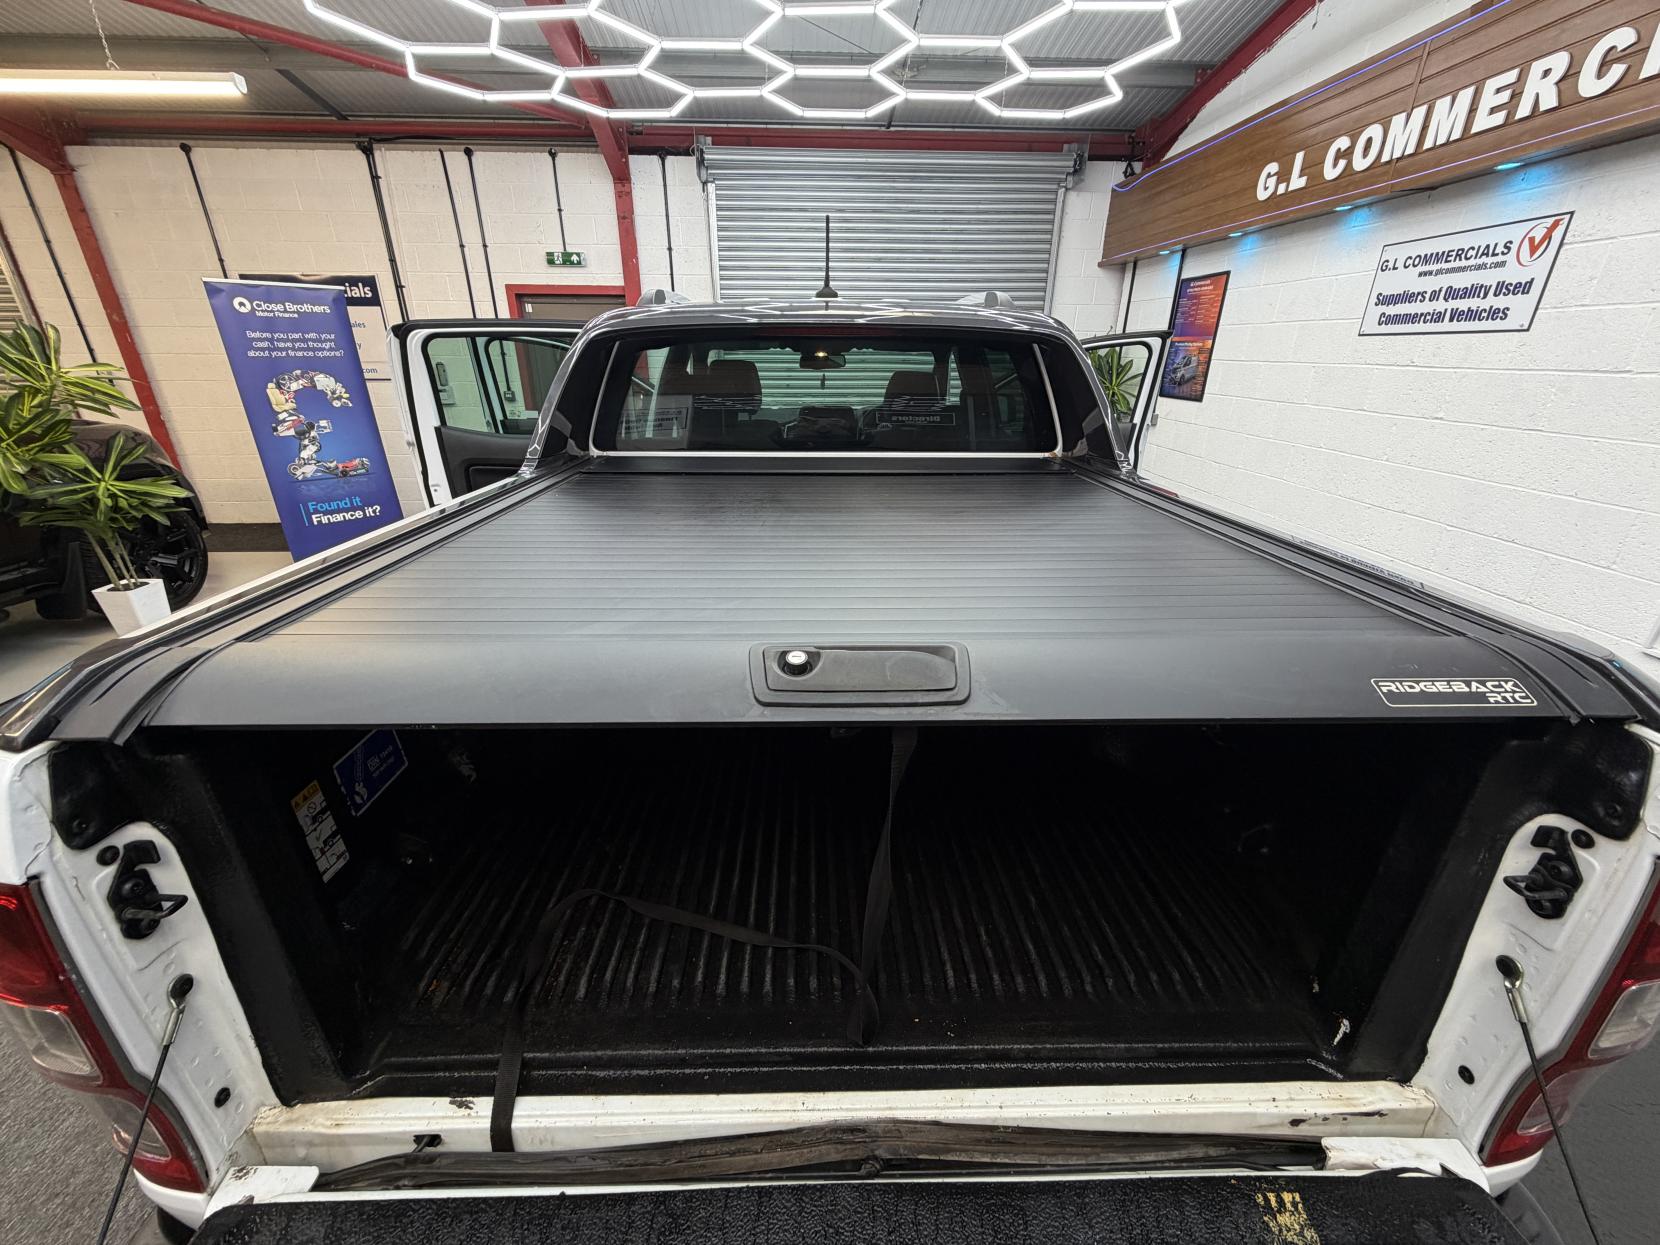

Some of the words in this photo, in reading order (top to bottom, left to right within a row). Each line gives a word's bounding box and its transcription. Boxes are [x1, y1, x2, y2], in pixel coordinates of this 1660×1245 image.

[1256, 150, 1308, 201] G.L
[1380, 257, 1399, 272] G.L
[1403, 240, 1514, 269] COMMERCIALS
[1417, 259, 1507, 278] www.glcommercials.com
[1374, 288, 1427, 307] Suppliers
[1428, 286, 1443, 302] of
[1443, 282, 1492, 302] Quality
[1493, 277, 1535, 297] Used
[252, 300, 285, 312] Close
[285, 302, 331, 313] Brothers
[1377, 308, 1448, 326] Commercial
[1448, 305, 1510, 323] Vehicles
[245, 330, 271, 338] Before
[274, 340, 293, 348] have
[308, 341, 335, 349] thought
[315, 350, 344, 358] options?
[308, 497, 351, 513] Found
[351, 496, 362, 506] it
[311, 510, 364, 525] Finance
[364, 505, 381, 517] it?
[1378, 681, 1524, 693] RIDGEBACK
[1486, 693, 1532, 703] RTC
